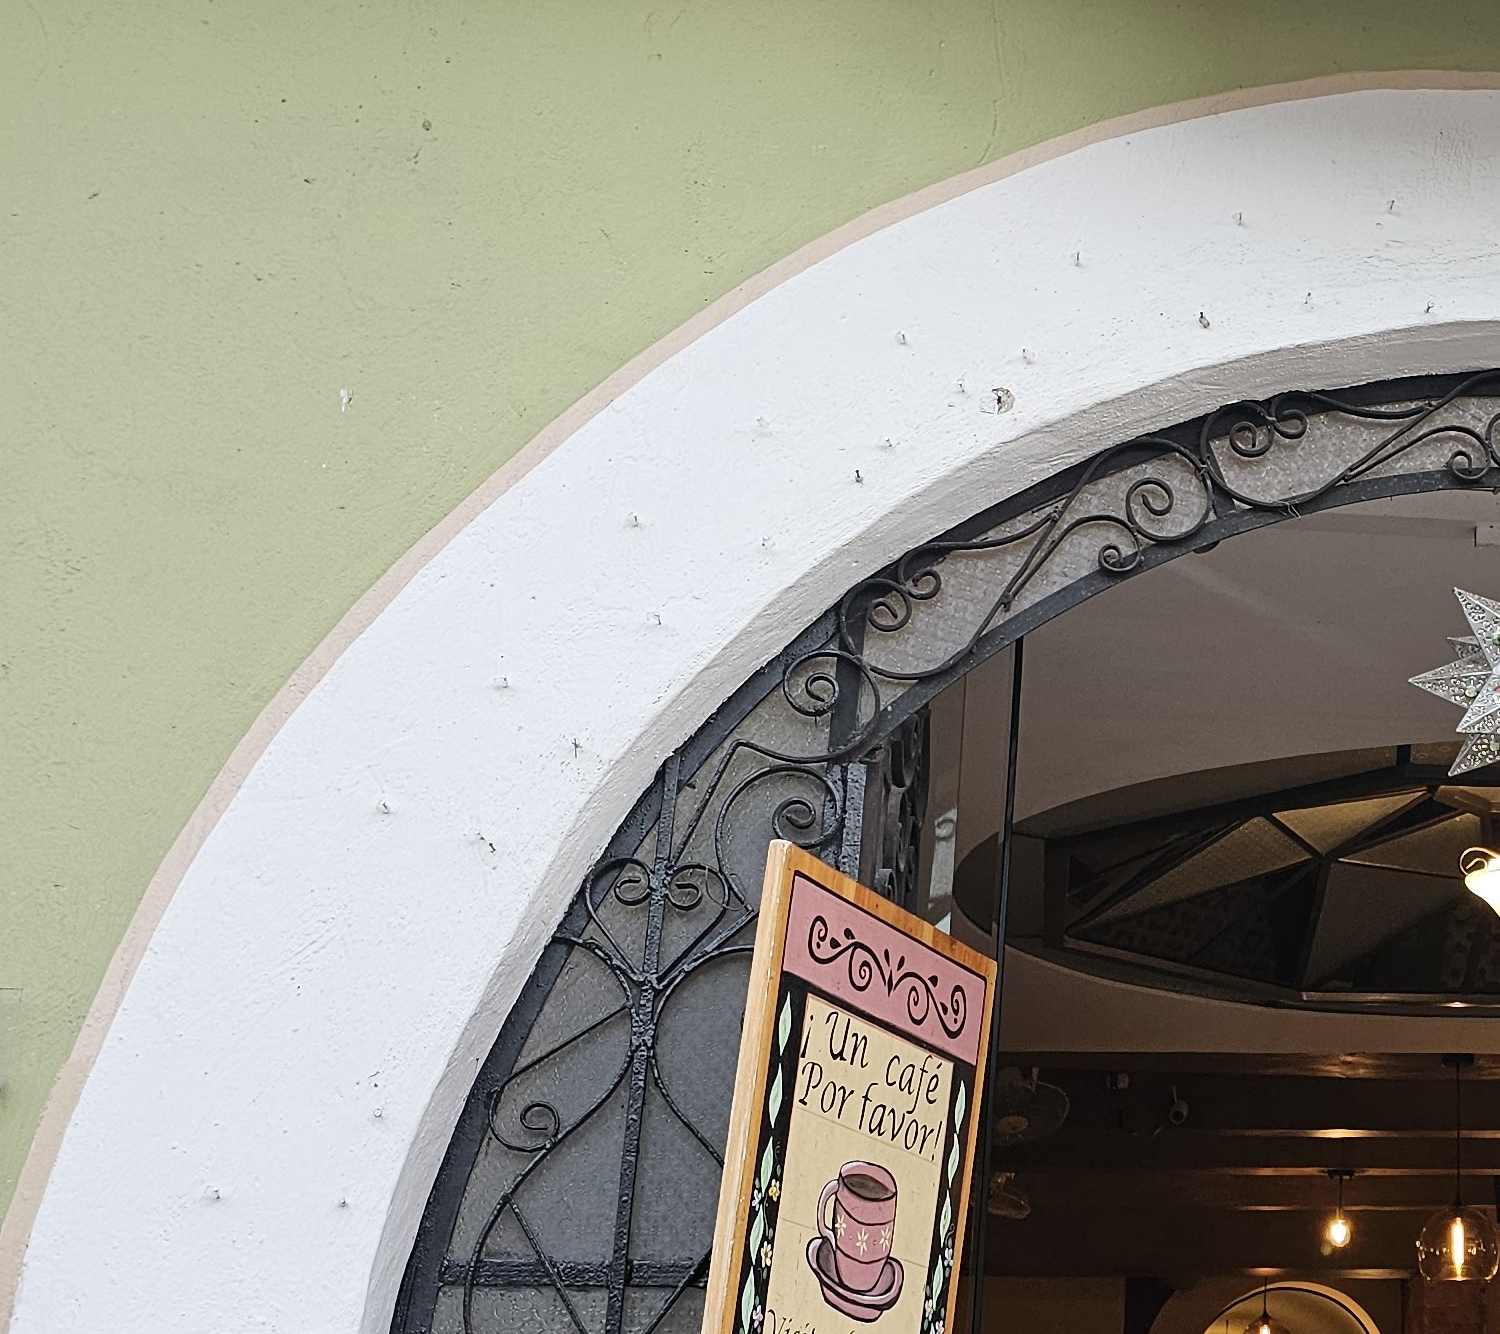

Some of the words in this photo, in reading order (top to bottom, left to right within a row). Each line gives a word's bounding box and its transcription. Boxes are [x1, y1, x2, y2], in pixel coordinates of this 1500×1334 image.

[798, 1061, 855, 1120] Por
[858, 1082, 943, 1162] favor!
[885, 1054, 943, 1114] café
